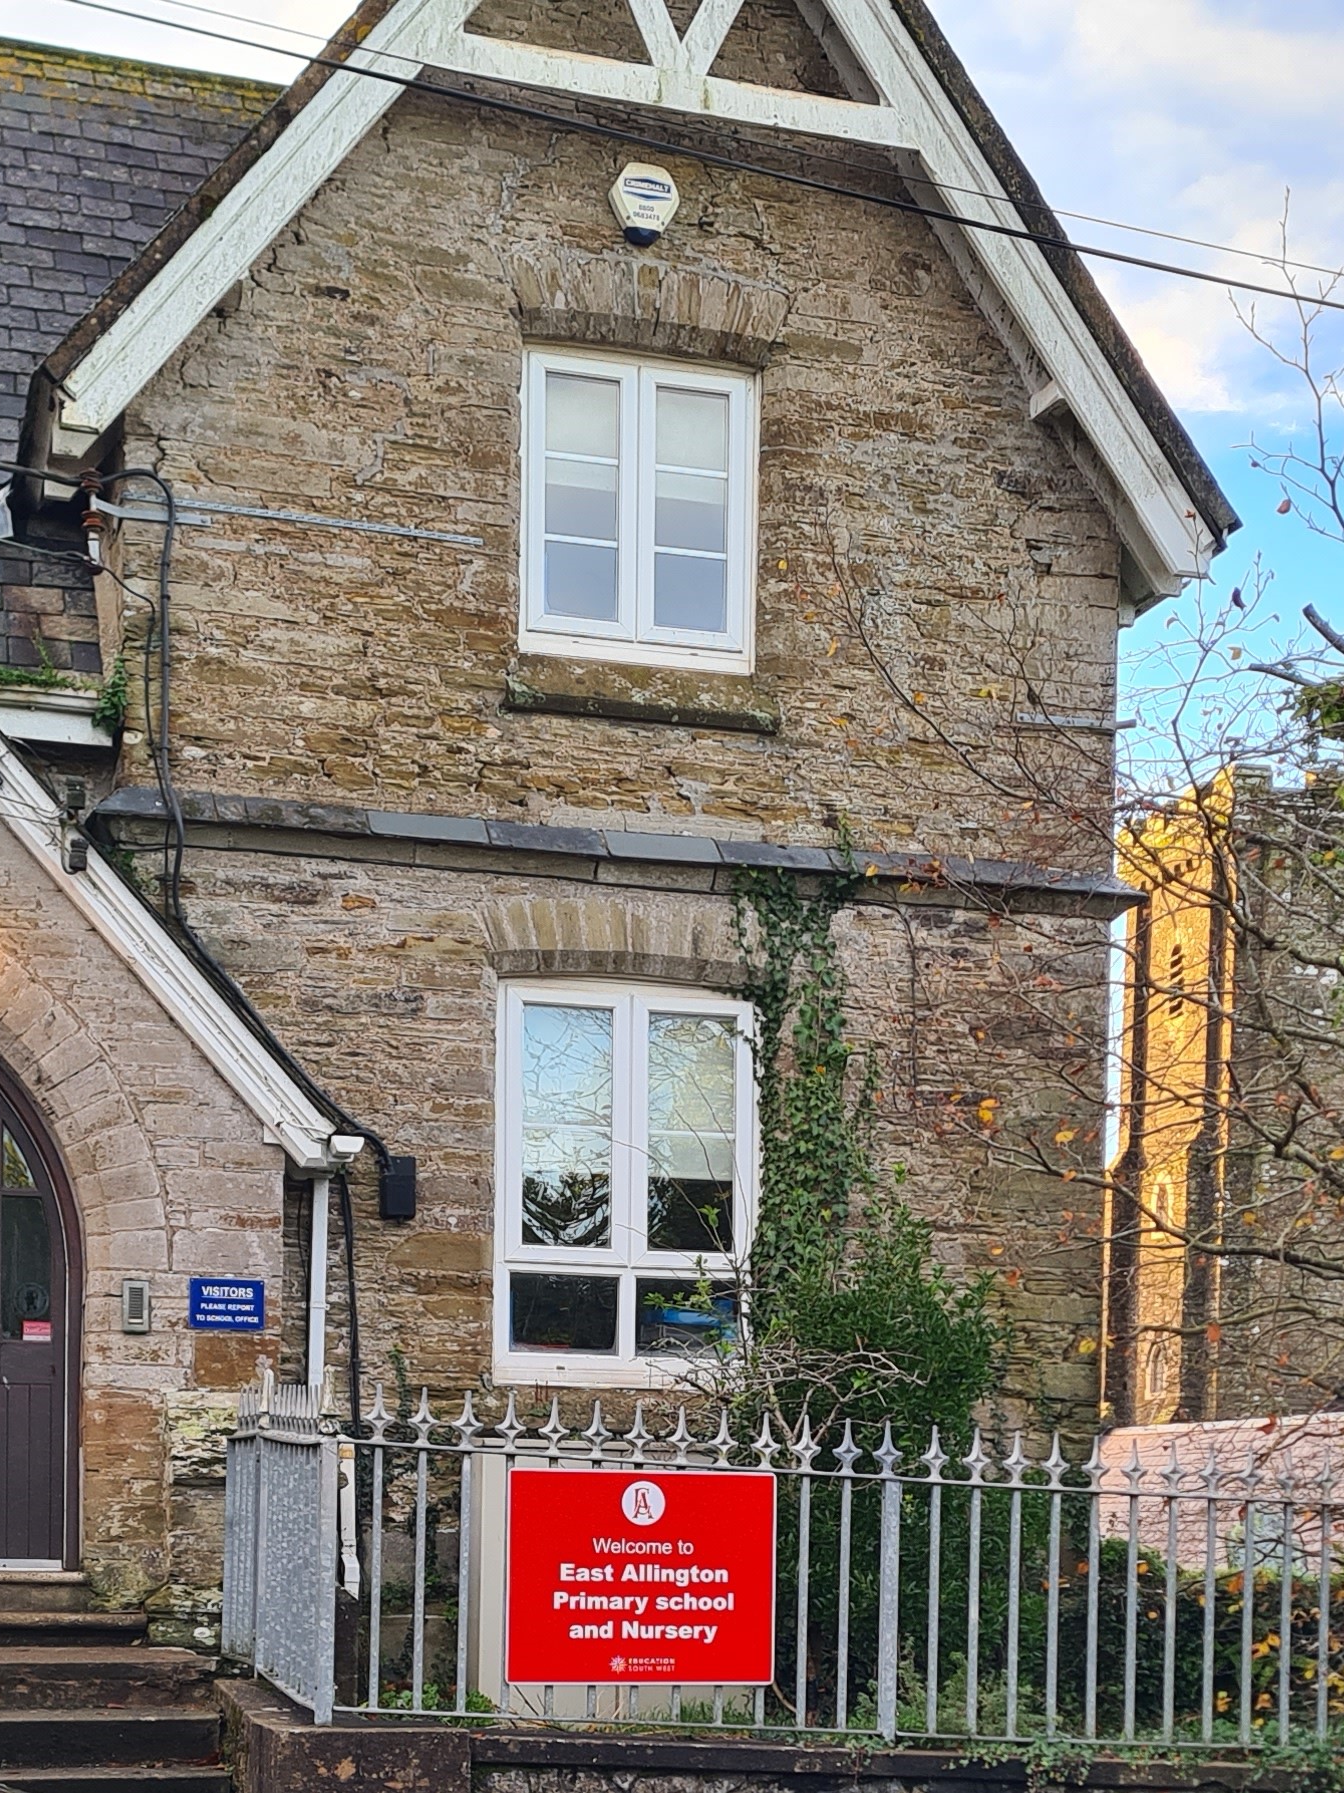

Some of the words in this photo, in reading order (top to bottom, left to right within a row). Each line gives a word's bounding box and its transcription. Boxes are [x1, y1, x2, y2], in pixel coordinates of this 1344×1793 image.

[201, 1285, 254, 1298] VISITORS
[592, 1537, 672, 1555] Welcome
[677, 1539, 694, 1555] to
[559, 1563, 614, 1582] East
[621, 1563, 729, 1587] Allington
[552, 1591, 648, 1615] Primary
[655, 1592, 735, 1611] school
[568, 1620, 614, 1639] and
[621, 1621, 718, 1644] Nursery
[628, 1657, 675, 1665] EDUCATION
